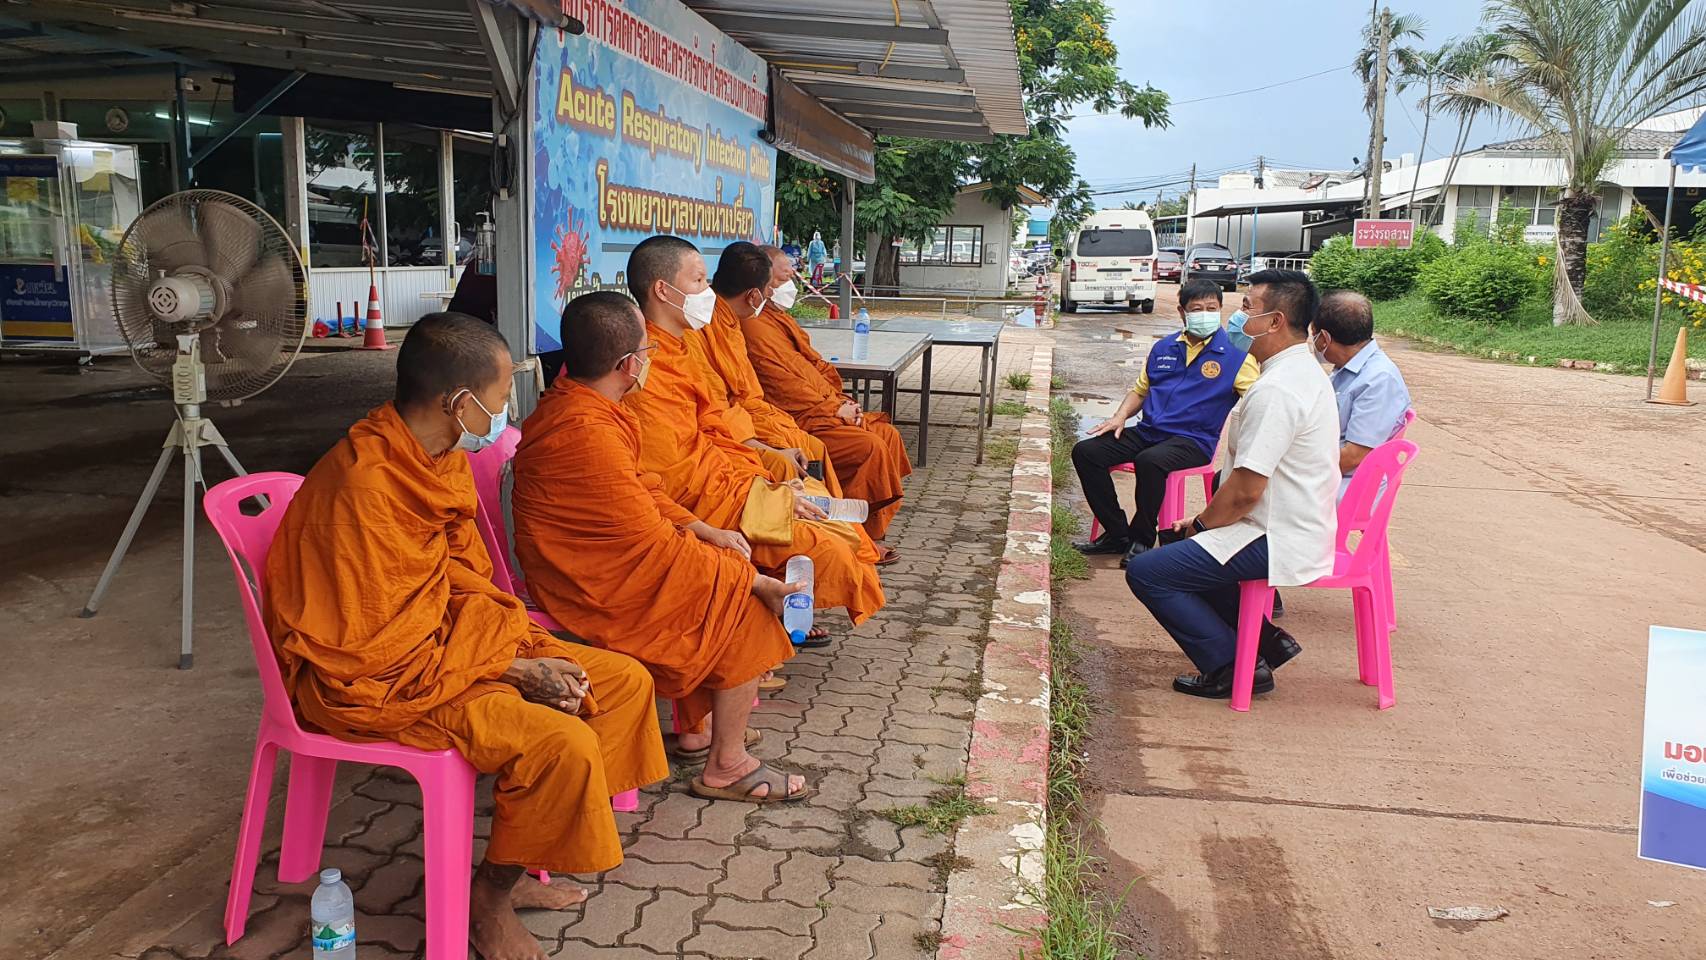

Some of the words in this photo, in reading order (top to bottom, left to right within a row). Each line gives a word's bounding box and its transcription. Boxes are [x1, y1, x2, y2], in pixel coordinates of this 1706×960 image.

[557, 71, 616, 131] Acute
[622, 93, 703, 167] Respiratory
[706, 124, 747, 174] Infection
[749, 144, 770, 178] Clinic
[597, 162, 755, 238] โรงพยาบาลบางน้ำเปรี้ยว
[1358, 224, 1410, 240] ระวังรถสวน
[1664, 741, 1706, 763] มอ
[1662, 768, 1706, 784] เพื่อช่วย
